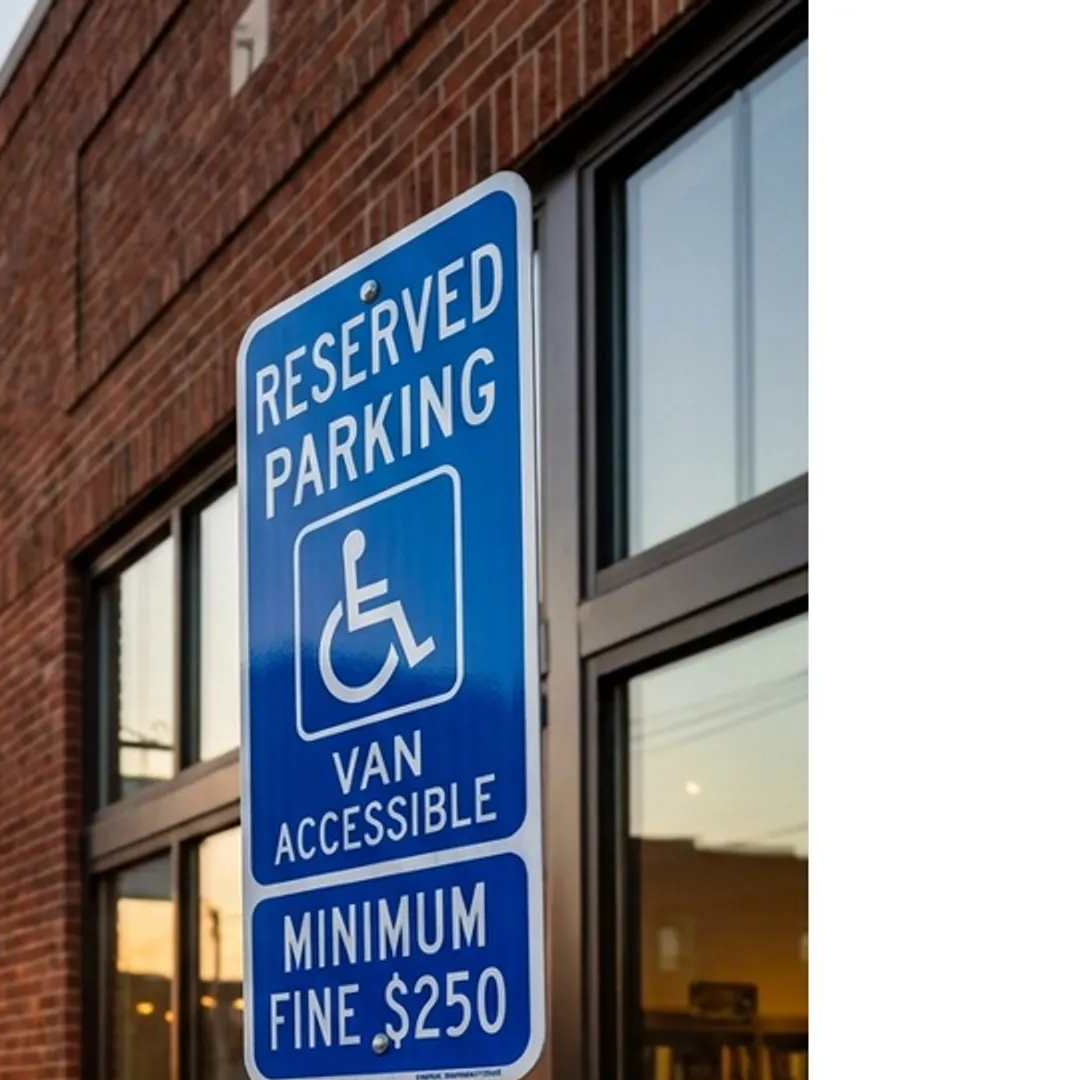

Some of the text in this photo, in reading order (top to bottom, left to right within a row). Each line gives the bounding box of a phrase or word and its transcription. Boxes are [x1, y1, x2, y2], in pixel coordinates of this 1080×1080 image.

[256, 242, 503, 435] RESERVED
[265, 347, 496, 519] PARKING
[332, 729, 422, 795] VAN
[274, 773, 497, 865] ACCESSIBLE
[283, 882, 486, 972] MINIMUM
[269, 965, 507, 1051] FINE $250
